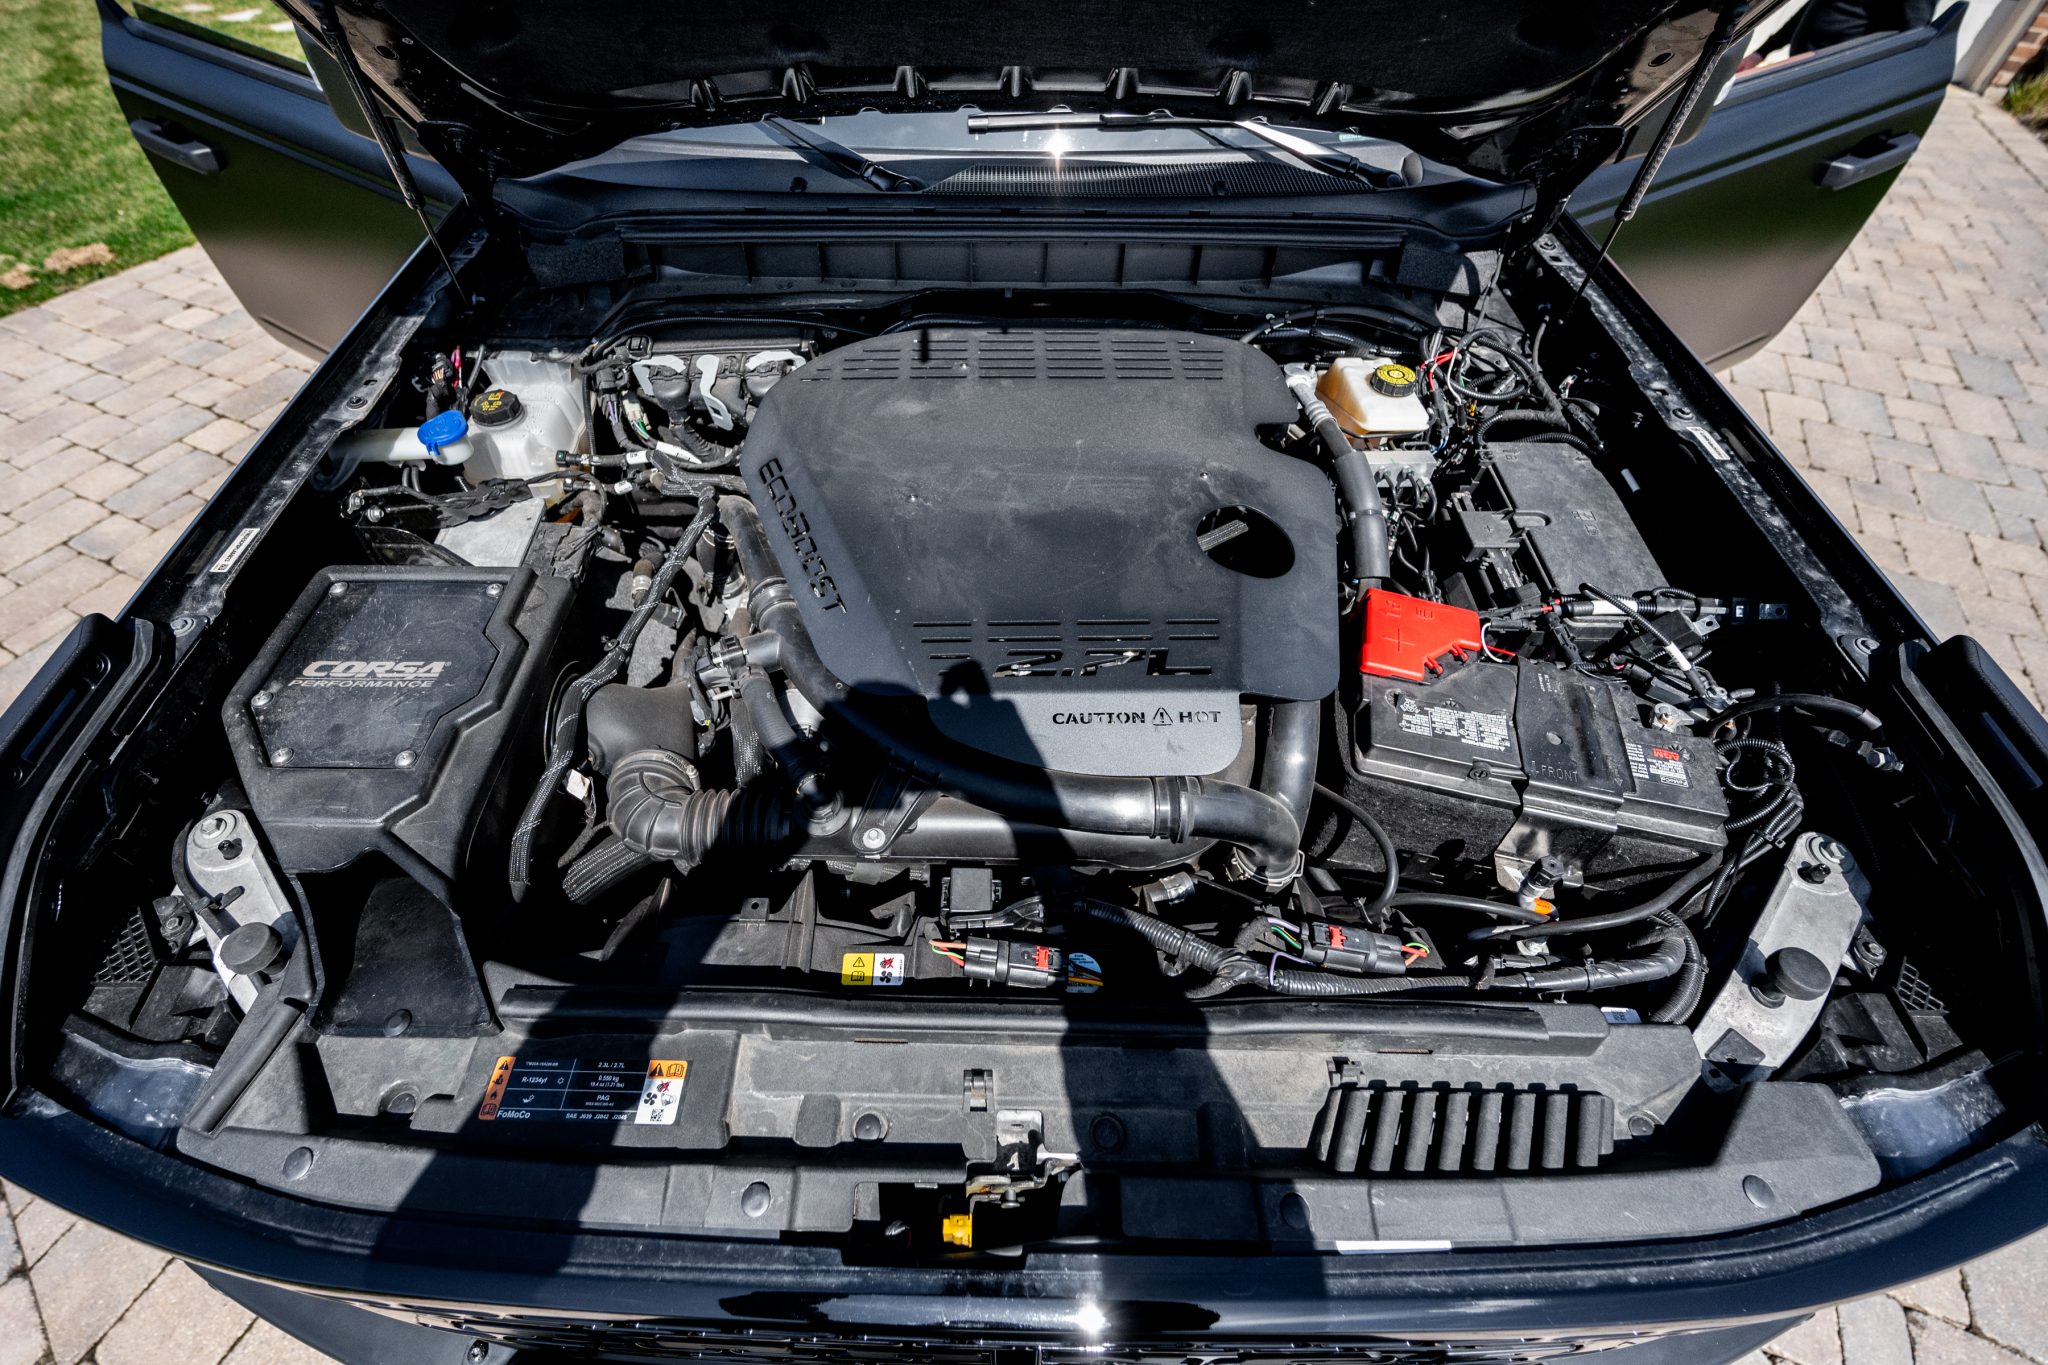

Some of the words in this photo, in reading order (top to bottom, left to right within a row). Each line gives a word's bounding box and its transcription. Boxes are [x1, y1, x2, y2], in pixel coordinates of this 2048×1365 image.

[759, 457, 847, 614] ECOBOOST
[302, 660, 446, 680] CORSA
[993, 648, 1212, 677] 2.7L
[288, 679, 435, 688] PERFORMANCE
[1052, 712, 1146, 725] CAUTION
[1178, 711, 1221, 724] HOT
[1541, 764, 1579, 783] FRONT
[521, 1076, 548, 1085] R-1234yf
[496, 1110, 531, 1119] FoMoCo
